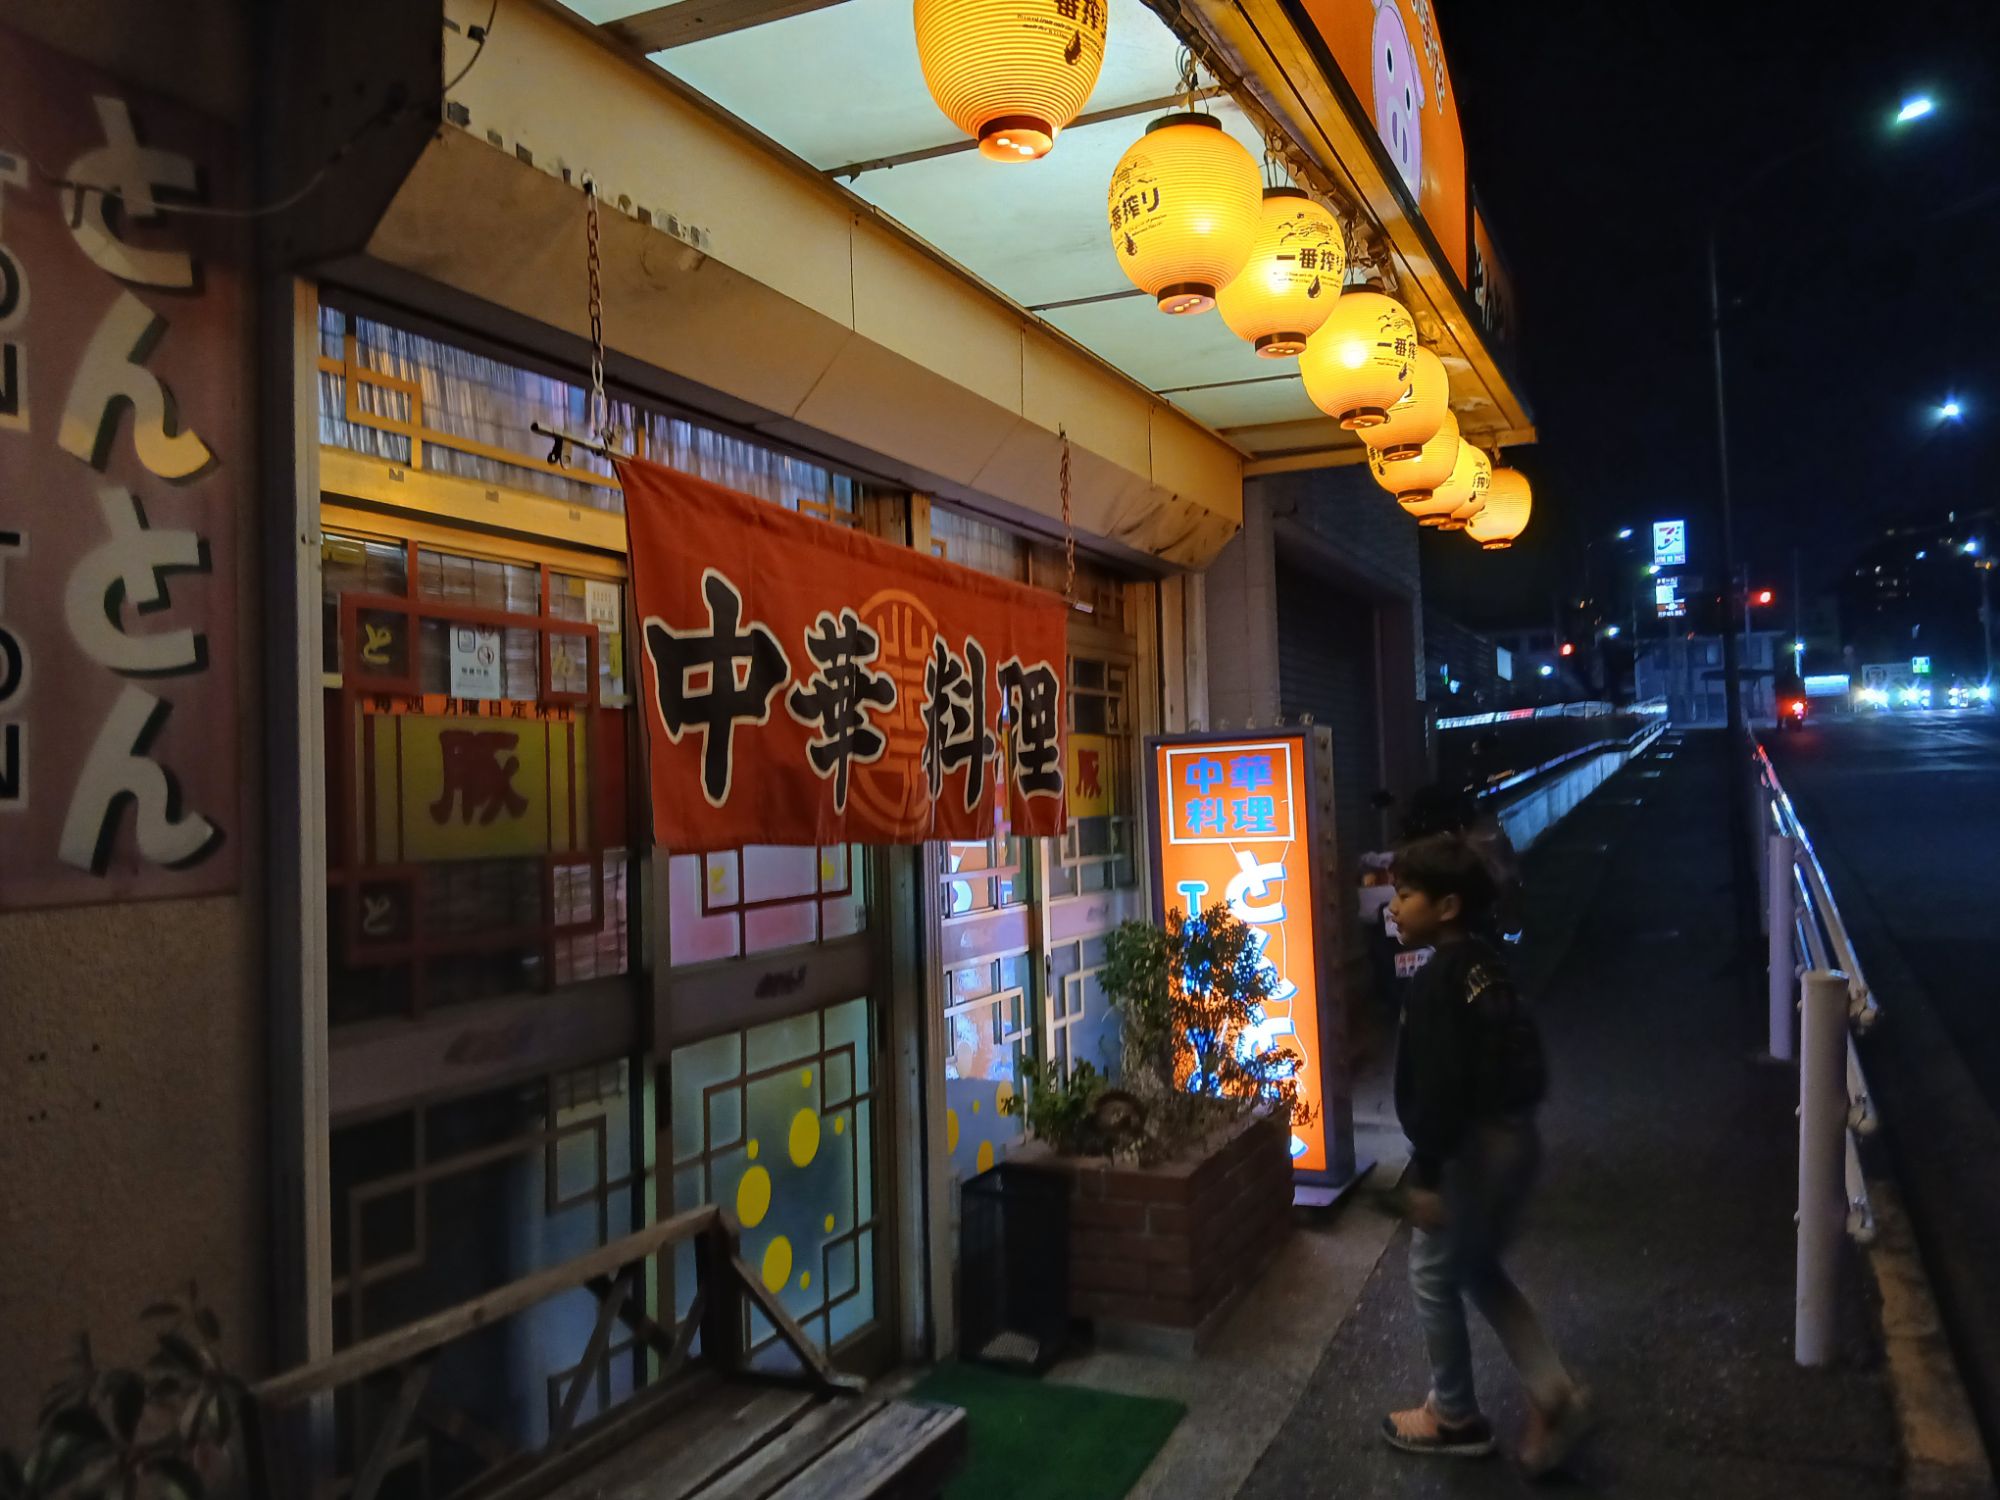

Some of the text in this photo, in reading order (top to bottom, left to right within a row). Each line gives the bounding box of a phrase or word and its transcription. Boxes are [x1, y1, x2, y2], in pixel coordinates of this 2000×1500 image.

[1276, 248, 1344, 275] 一番搾り
[58, 95, 222, 876] とんとん
[643, 567, 1065, 816] 中華料理
[1185, 756, 1274, 795] 中華
[1185, 796, 1278, 834] 料理
[1225, 850, 1309, 1160] とんと
